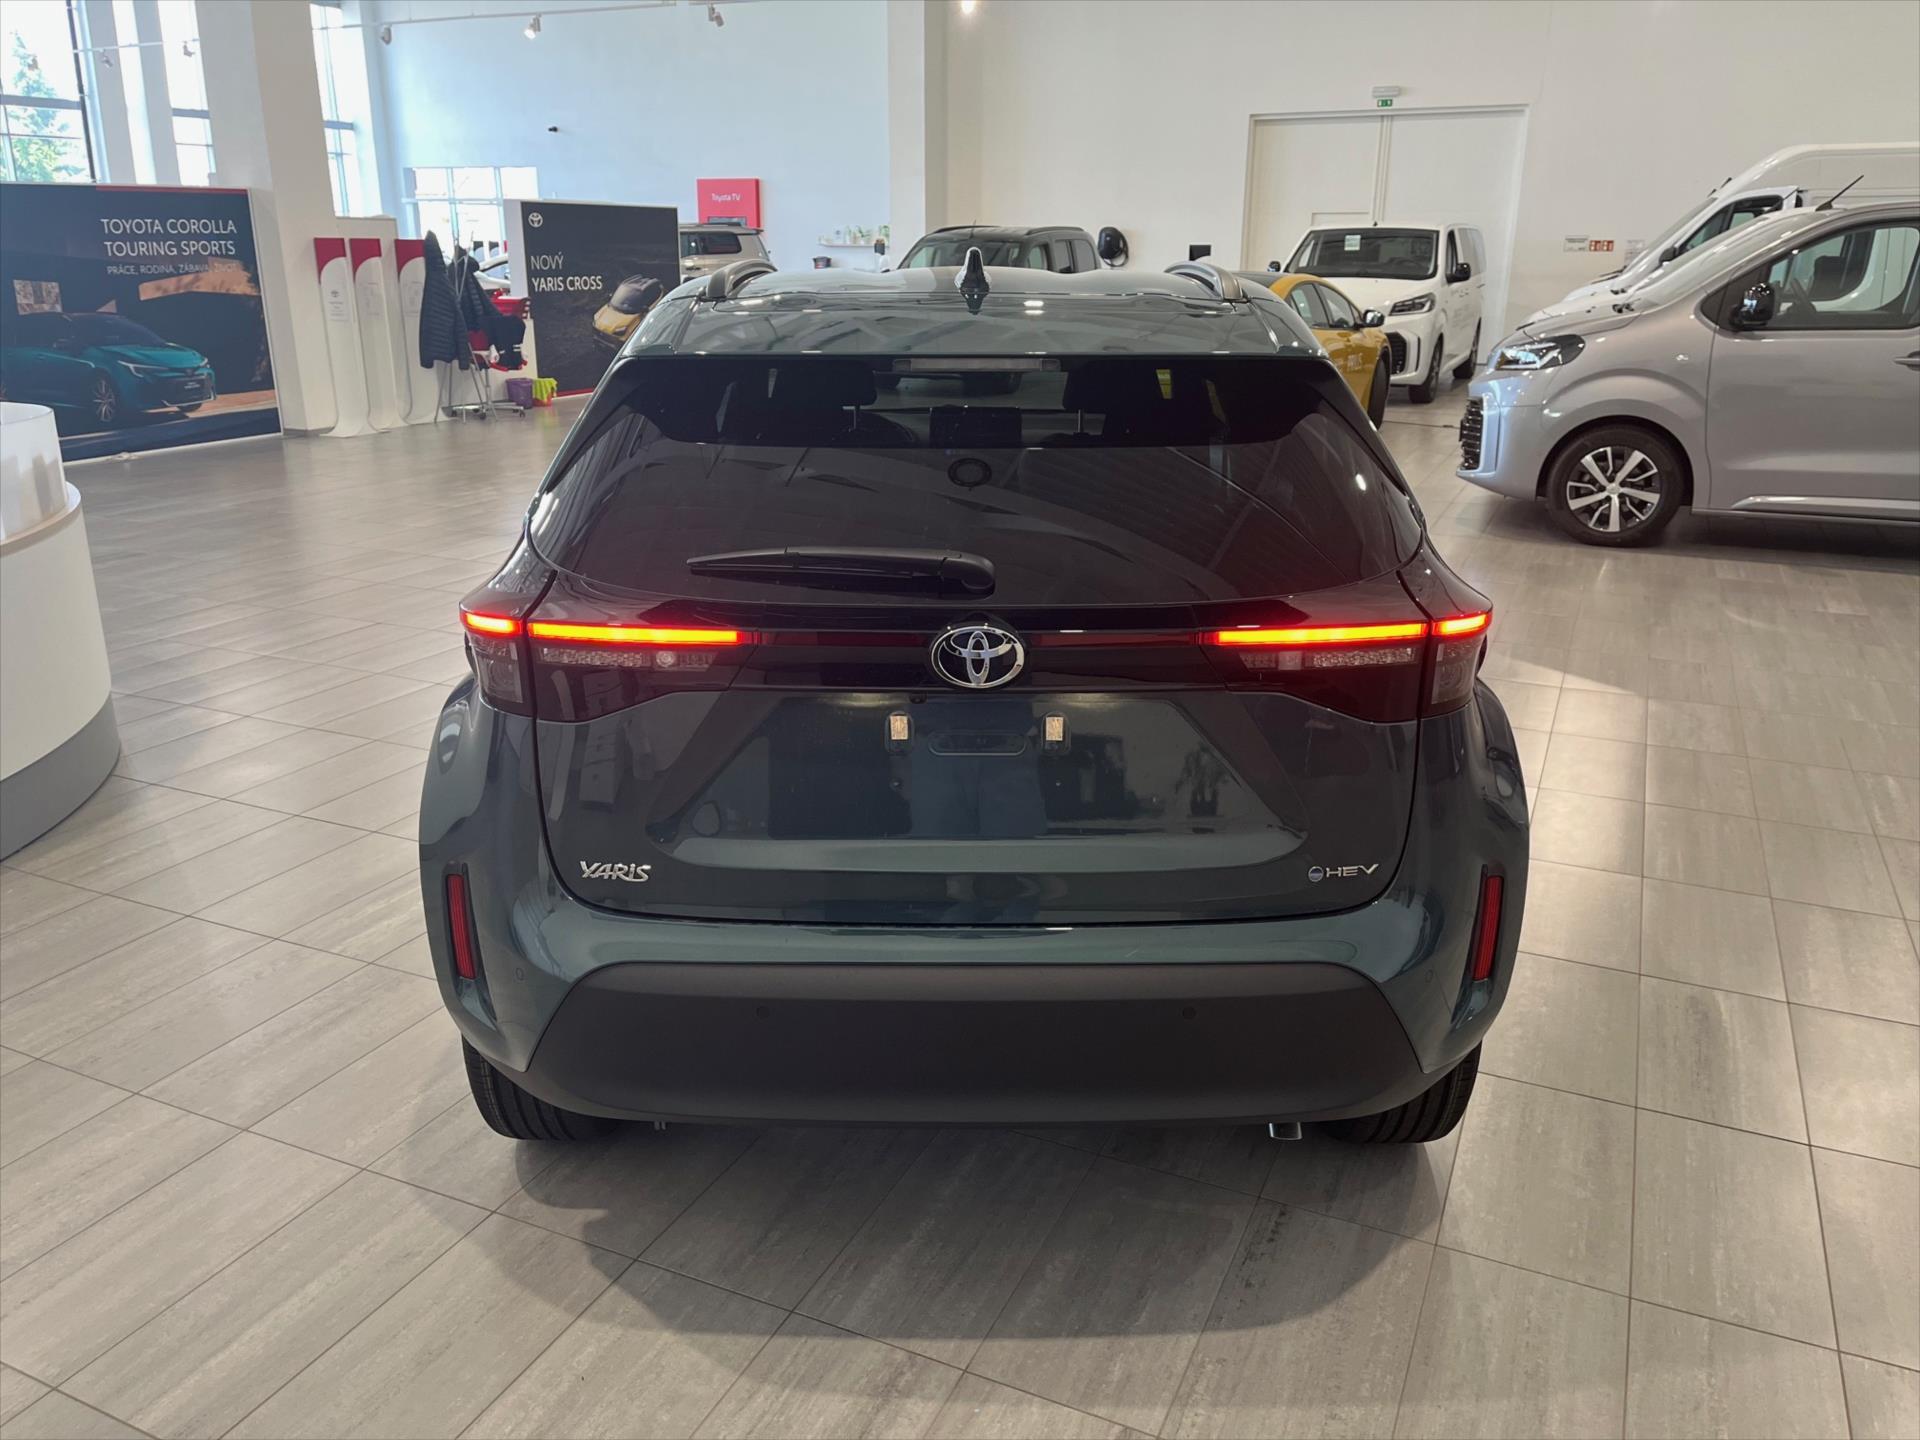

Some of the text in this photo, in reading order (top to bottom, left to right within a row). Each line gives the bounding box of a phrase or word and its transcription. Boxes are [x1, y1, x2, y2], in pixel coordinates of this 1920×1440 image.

[711, 193, 741, 203] Toyota TV
[100, 218, 238, 235] TOYOTA COROLLA
[103, 240, 236, 257] TOURING SPORTS
[530, 251, 564, 271] NOVÝ
[531, 275, 603, 292] YARIS CROSS
[579, 860, 652, 882] YARIS
[1325, 863, 1379, 878] HEV
